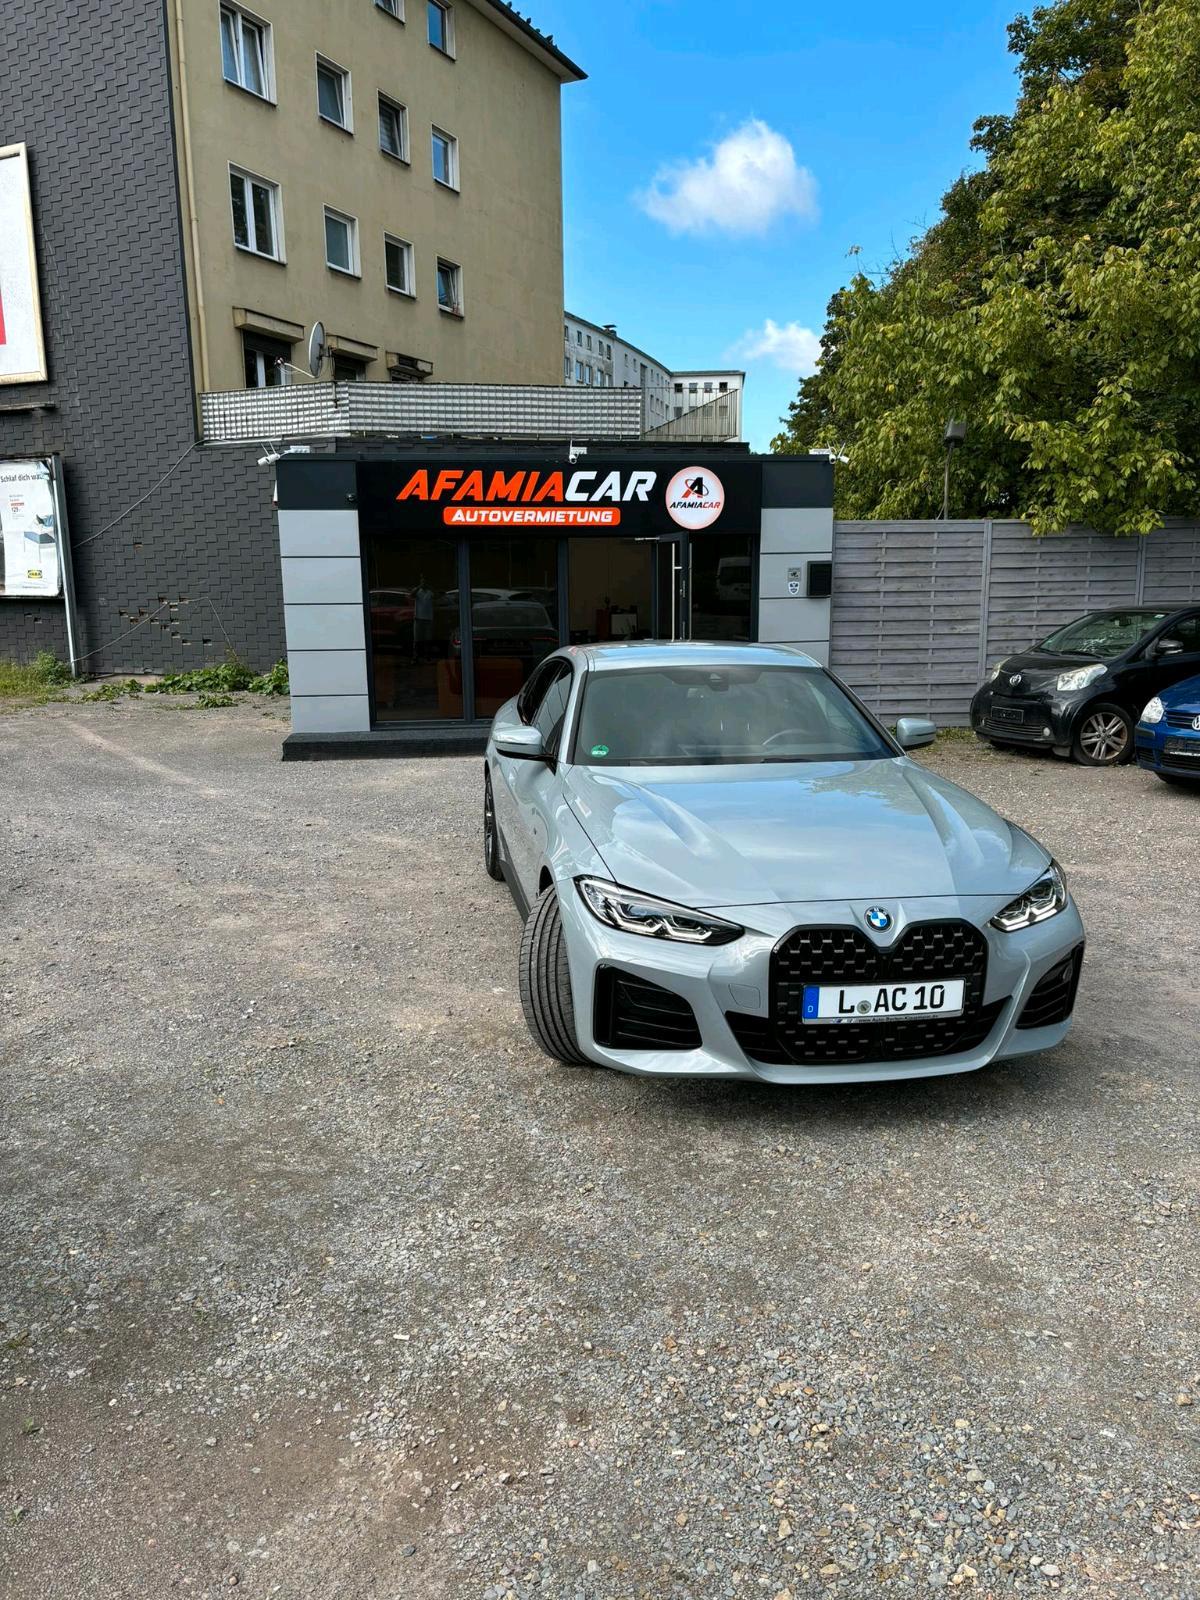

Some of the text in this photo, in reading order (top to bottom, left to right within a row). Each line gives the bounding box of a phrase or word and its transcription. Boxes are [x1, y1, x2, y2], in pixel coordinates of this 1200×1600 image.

[396, 469, 657, 502] AFAMIACAR
[670, 501, 721, 509] AFAMIACAR
[808, 985, 946, 1014] D L AC 10
